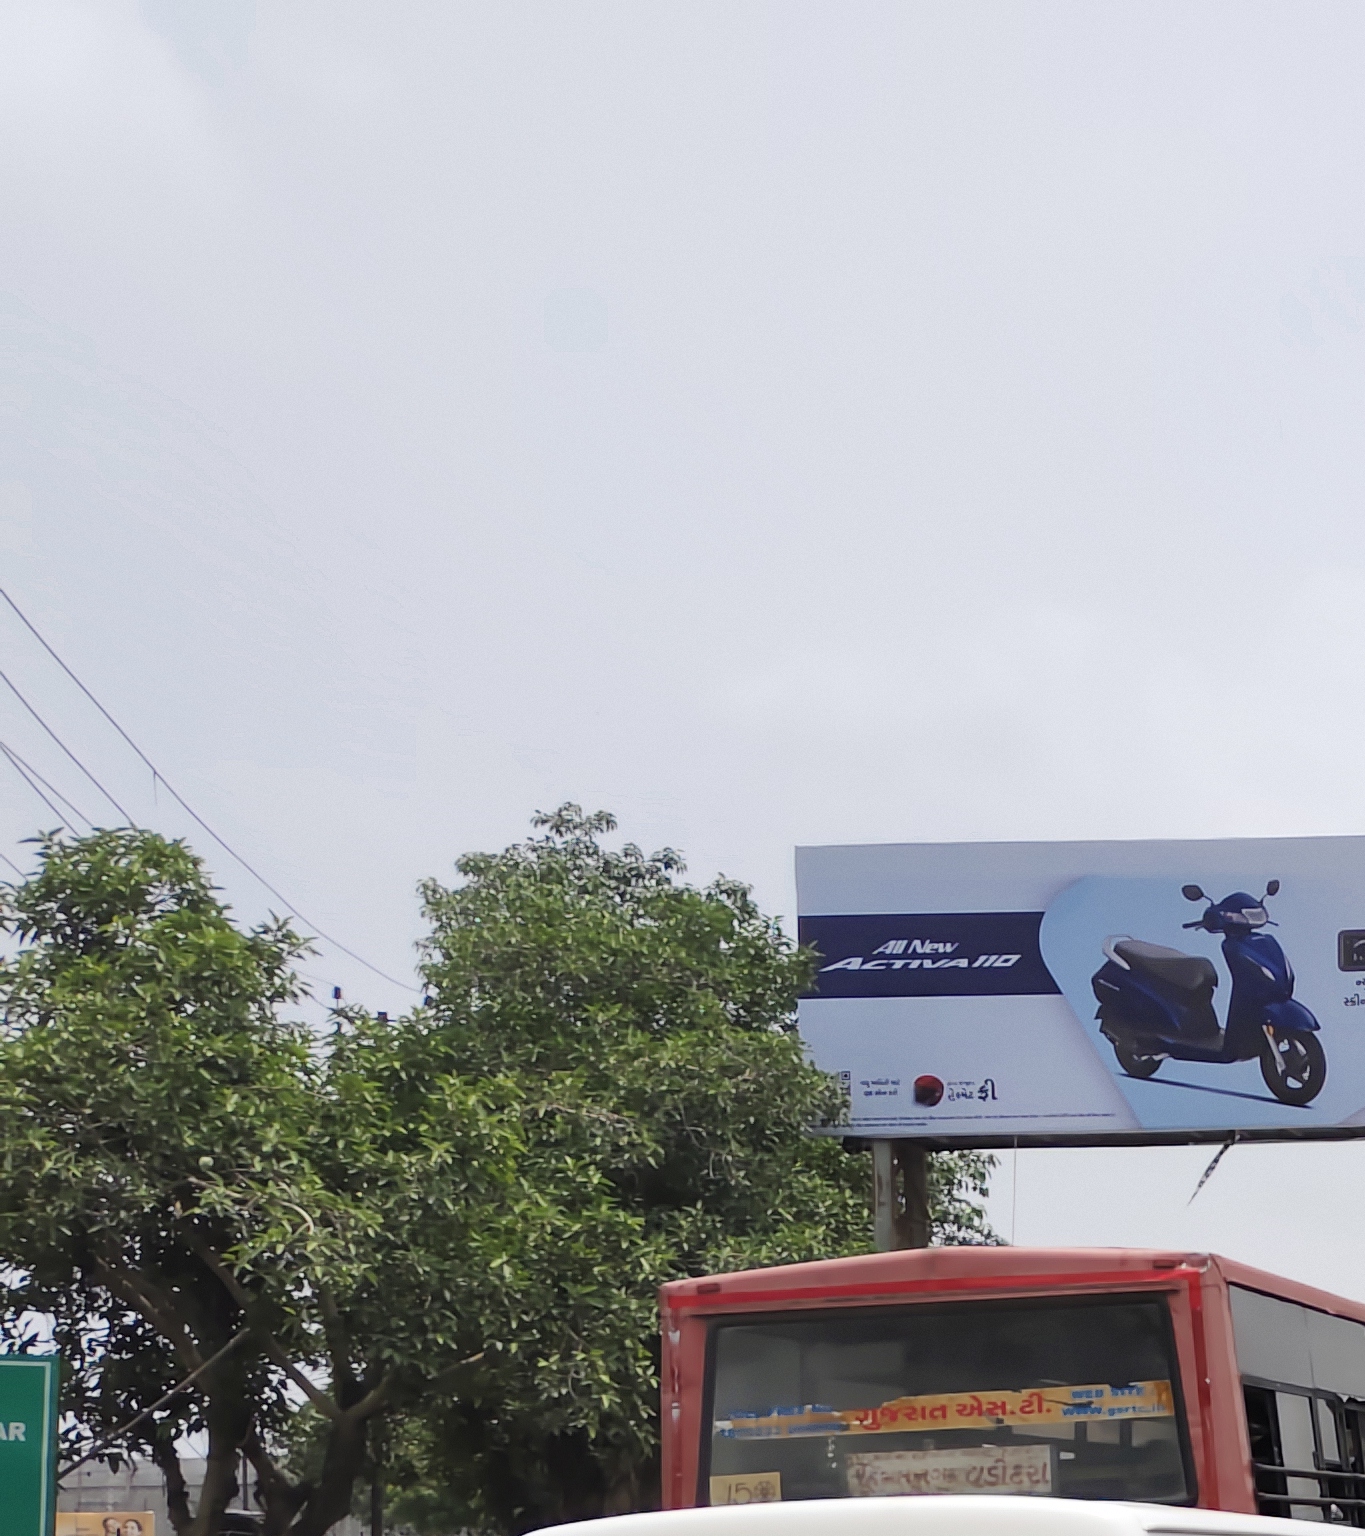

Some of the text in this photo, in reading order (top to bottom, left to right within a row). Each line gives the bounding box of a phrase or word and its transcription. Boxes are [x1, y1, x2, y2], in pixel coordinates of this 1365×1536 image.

[908, 939, 959, 954] New
[971, 954, 1022, 967] 110
[855, 1404, 947, 1431] ગુજરાત
